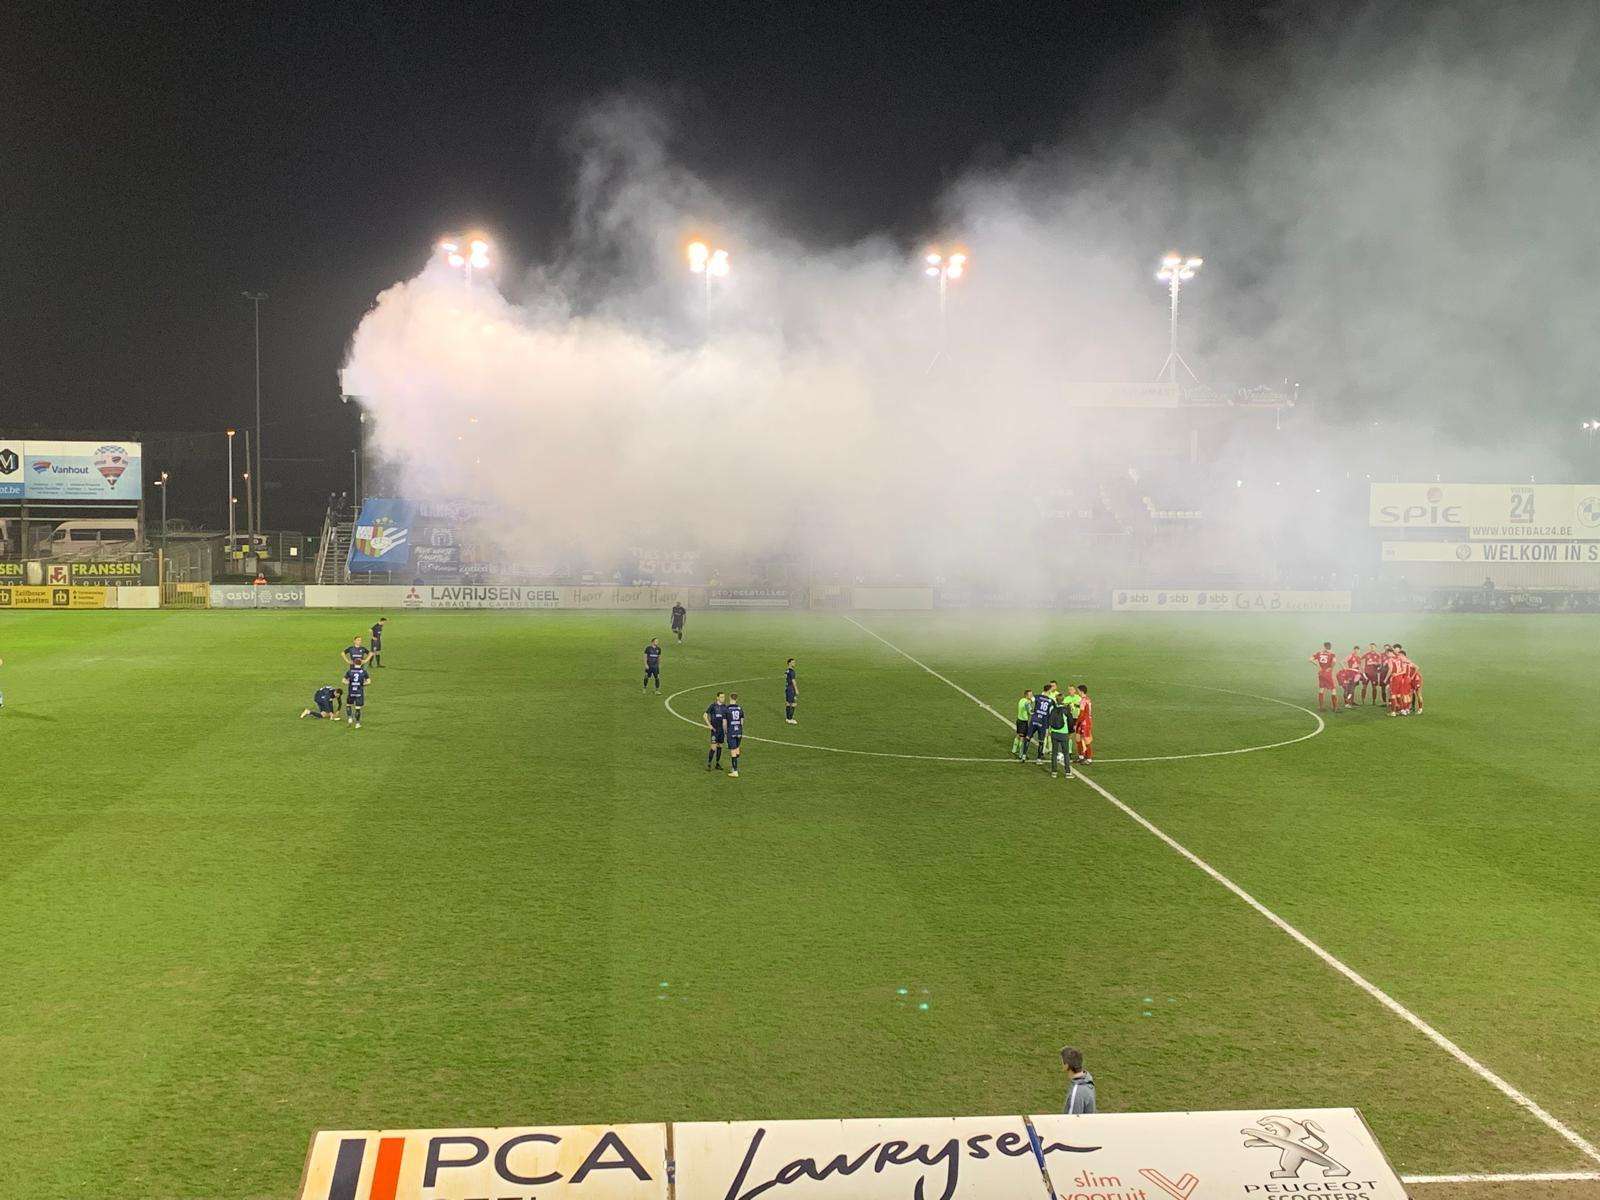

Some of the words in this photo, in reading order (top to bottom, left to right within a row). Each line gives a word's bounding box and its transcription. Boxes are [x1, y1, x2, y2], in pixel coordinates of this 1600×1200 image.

[52, 465, 89, 475] Vanhout
[1510, 494, 1536, 523] 24
[1472, 526, 1573, 536] WWW.VOETBAL24.BE
[1484, 544, 1557, 561] WELKOM
[1565, 544, 1581, 561] IN
[72, 563, 141, 575] FRANSSEN
[431, 587, 521, 601] LAVRIJSEN
[527, 590, 559, 601] GEEL
[353, 673, 360, 682] 3
[1040, 701, 1049, 712] 16
[423, 1131, 654, 1187] PCA
[1074, 1170, 1122, 1188] slim
[1244, 1181, 1377, 1193] PEUGEOT
